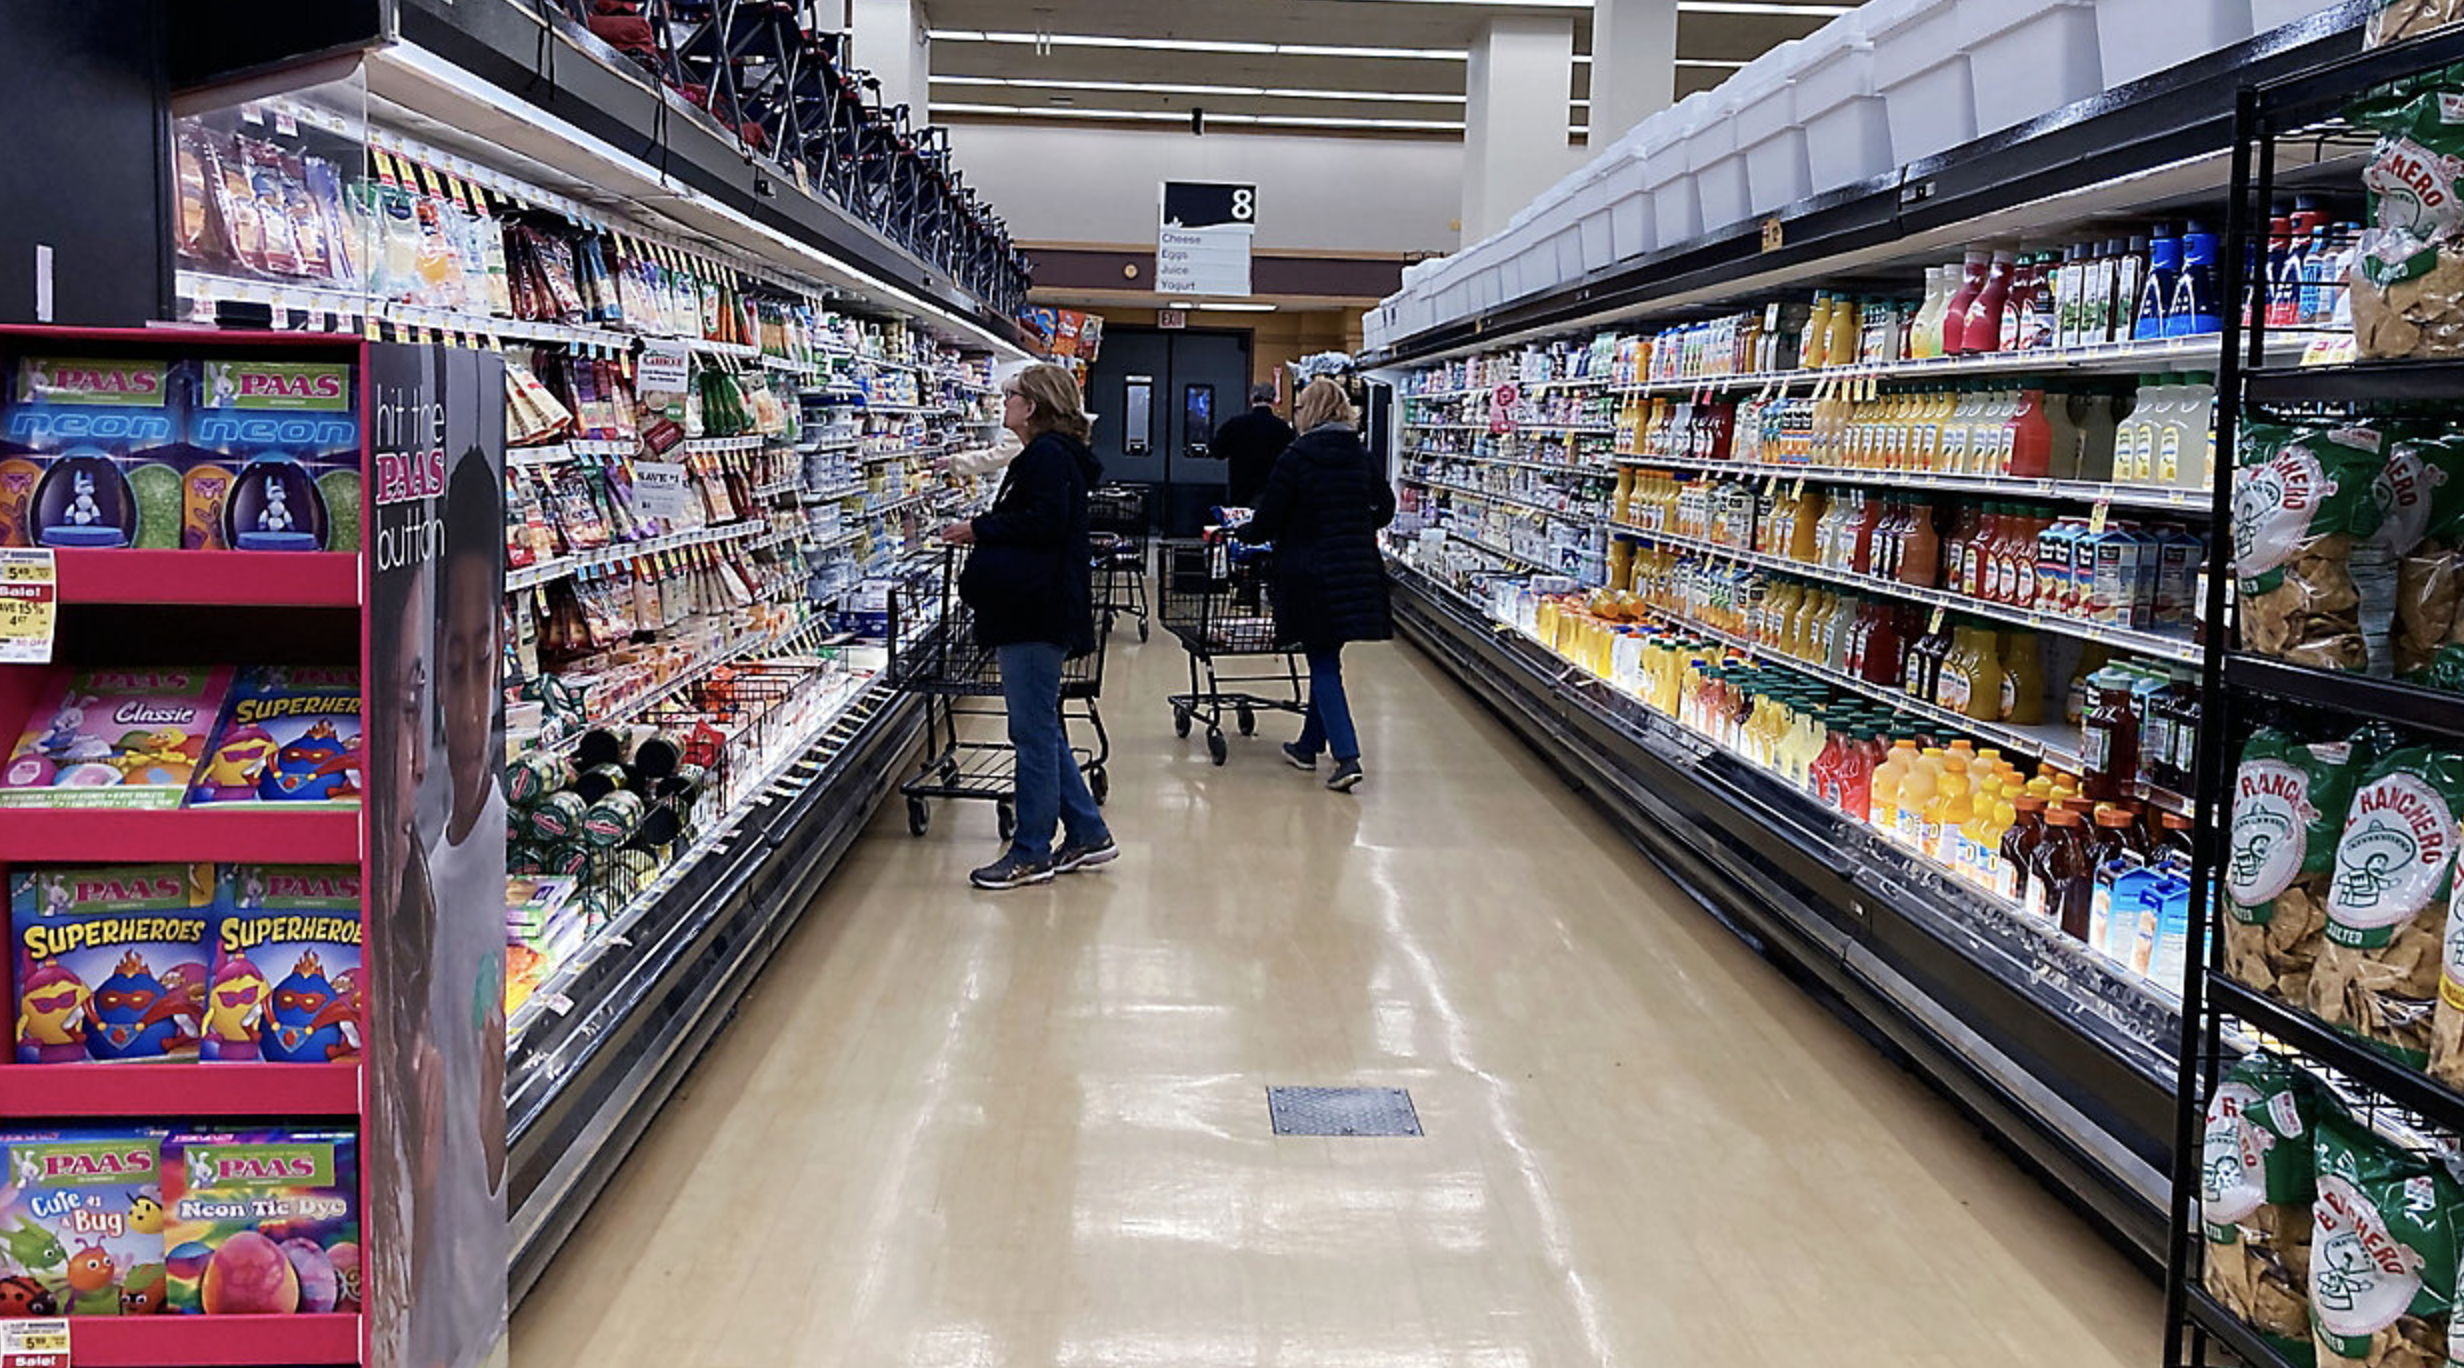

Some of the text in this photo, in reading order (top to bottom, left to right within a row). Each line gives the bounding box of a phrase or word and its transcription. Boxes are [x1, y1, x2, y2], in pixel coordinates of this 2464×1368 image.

[1232, 189, 1252, 220] 8
[1162, 233, 1201, 243] Cheese
[1162, 249, 1189, 261] Eggs
[1161, 265, 1189, 275] Juice
[1161, 280, 1195, 291] Yogurt
[1162, 311, 1183, 326] EXIT
[54, 369, 158, 394] PAAS
[239, 372, 341, 399] PAAS
[12, 411, 171, 440] neon
[200, 415, 356, 443] neon
[377, 384, 445, 447] hit the
[376, 449, 444, 505] PAAS
[377, 506, 446, 572] button
[90, 671, 190, 689] PAAS
[115, 701, 197, 725] Classic
[75, 873, 182, 903] PAAS
[268, 874, 361, 900] PAAS
[24, 918, 207, 961] SUPERHEROES
[43, 1150, 152, 1178] PAAS
[216, 1157, 315, 1179] PAAS
[31, 1191, 81, 1218] Cute
[180, 1201, 246, 1219] Neon
[298, 1199, 347, 1221] Dye
[74, 1209, 124, 1238] Bug
